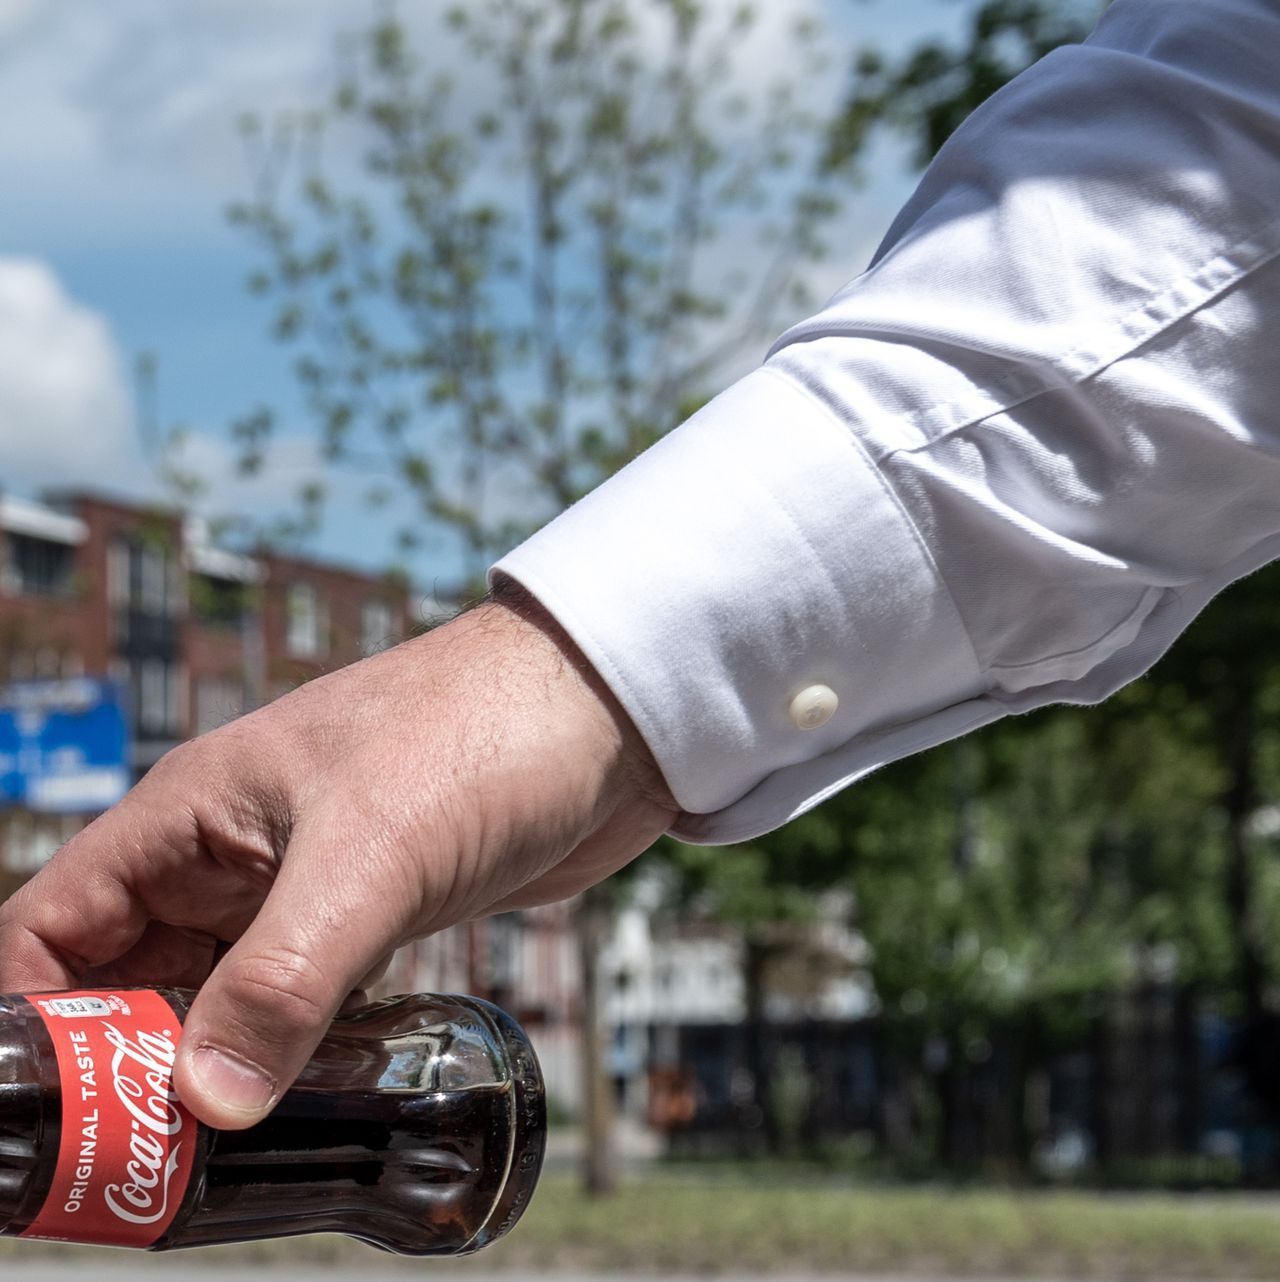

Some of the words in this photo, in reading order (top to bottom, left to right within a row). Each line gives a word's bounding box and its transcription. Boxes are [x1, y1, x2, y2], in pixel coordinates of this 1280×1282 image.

[68, 1029, 99, 1101] TASTE
[63, 1107, 100, 1213] ORIGINAL
[100, 1020, 182, 1225] Coca-Cola
